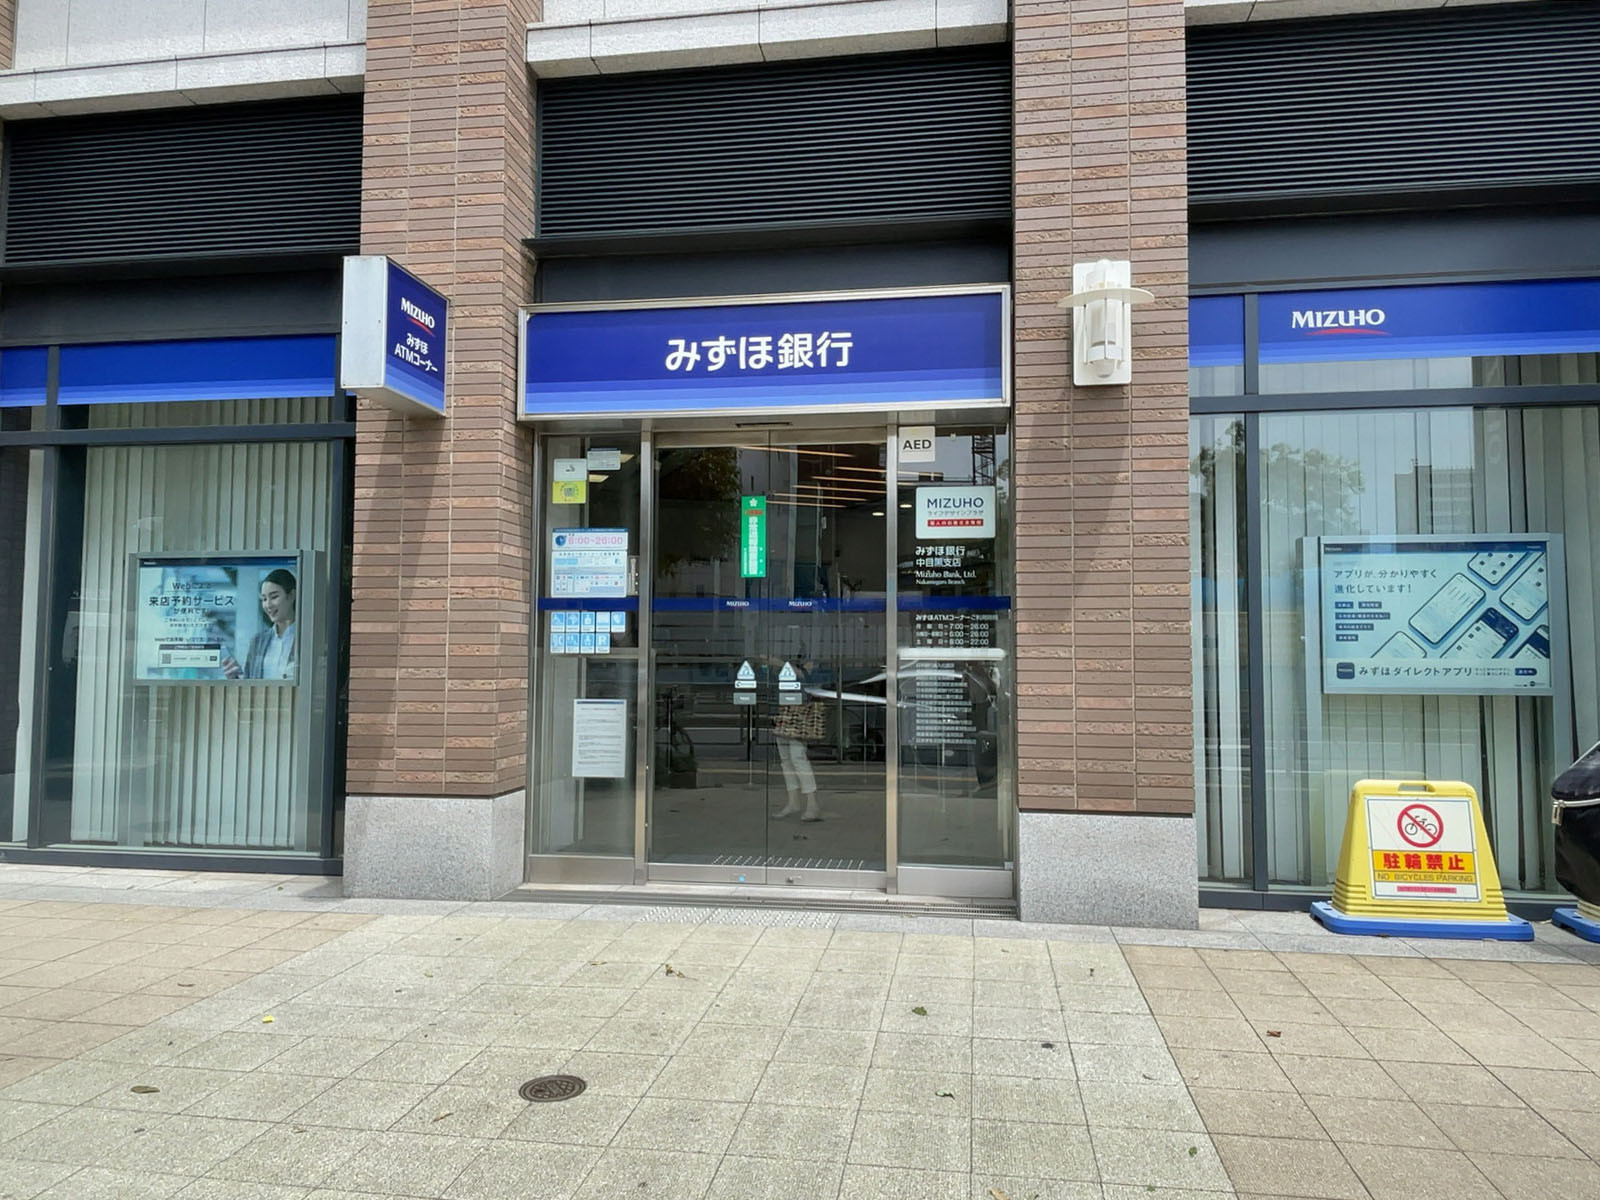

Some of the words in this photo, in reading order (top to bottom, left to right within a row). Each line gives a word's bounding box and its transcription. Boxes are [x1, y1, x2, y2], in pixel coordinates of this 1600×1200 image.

[401, 297, 436, 329] MIZUHO
[1291, 308, 1386, 329] MIZUHO
[406, 332, 429, 356] みずほ
[664, 331, 854, 372] みずほ銀行
[394, 343, 439, 373] ATMコーナー
[902, 439, 932, 450] AED
[927, 497, 984, 508] MIZUHO
[915, 545, 966, 556] みずほ銀行
[914, 569, 942, 578] Mizuho
[942, 569, 962, 579] Bank,
[963, 569, 977, 578] Ltd.
[148, 595, 234, 607] 来店予約サービス
[1359, 666, 1472, 677] みずほダイレクトアプリ
[1383, 853, 1465, 871] 駐輪禁止
[1377, 873, 1390, 881] NO
[1394, 873, 1436, 882] BICYCLES
[1436, 874, 1473, 883] PARKING
